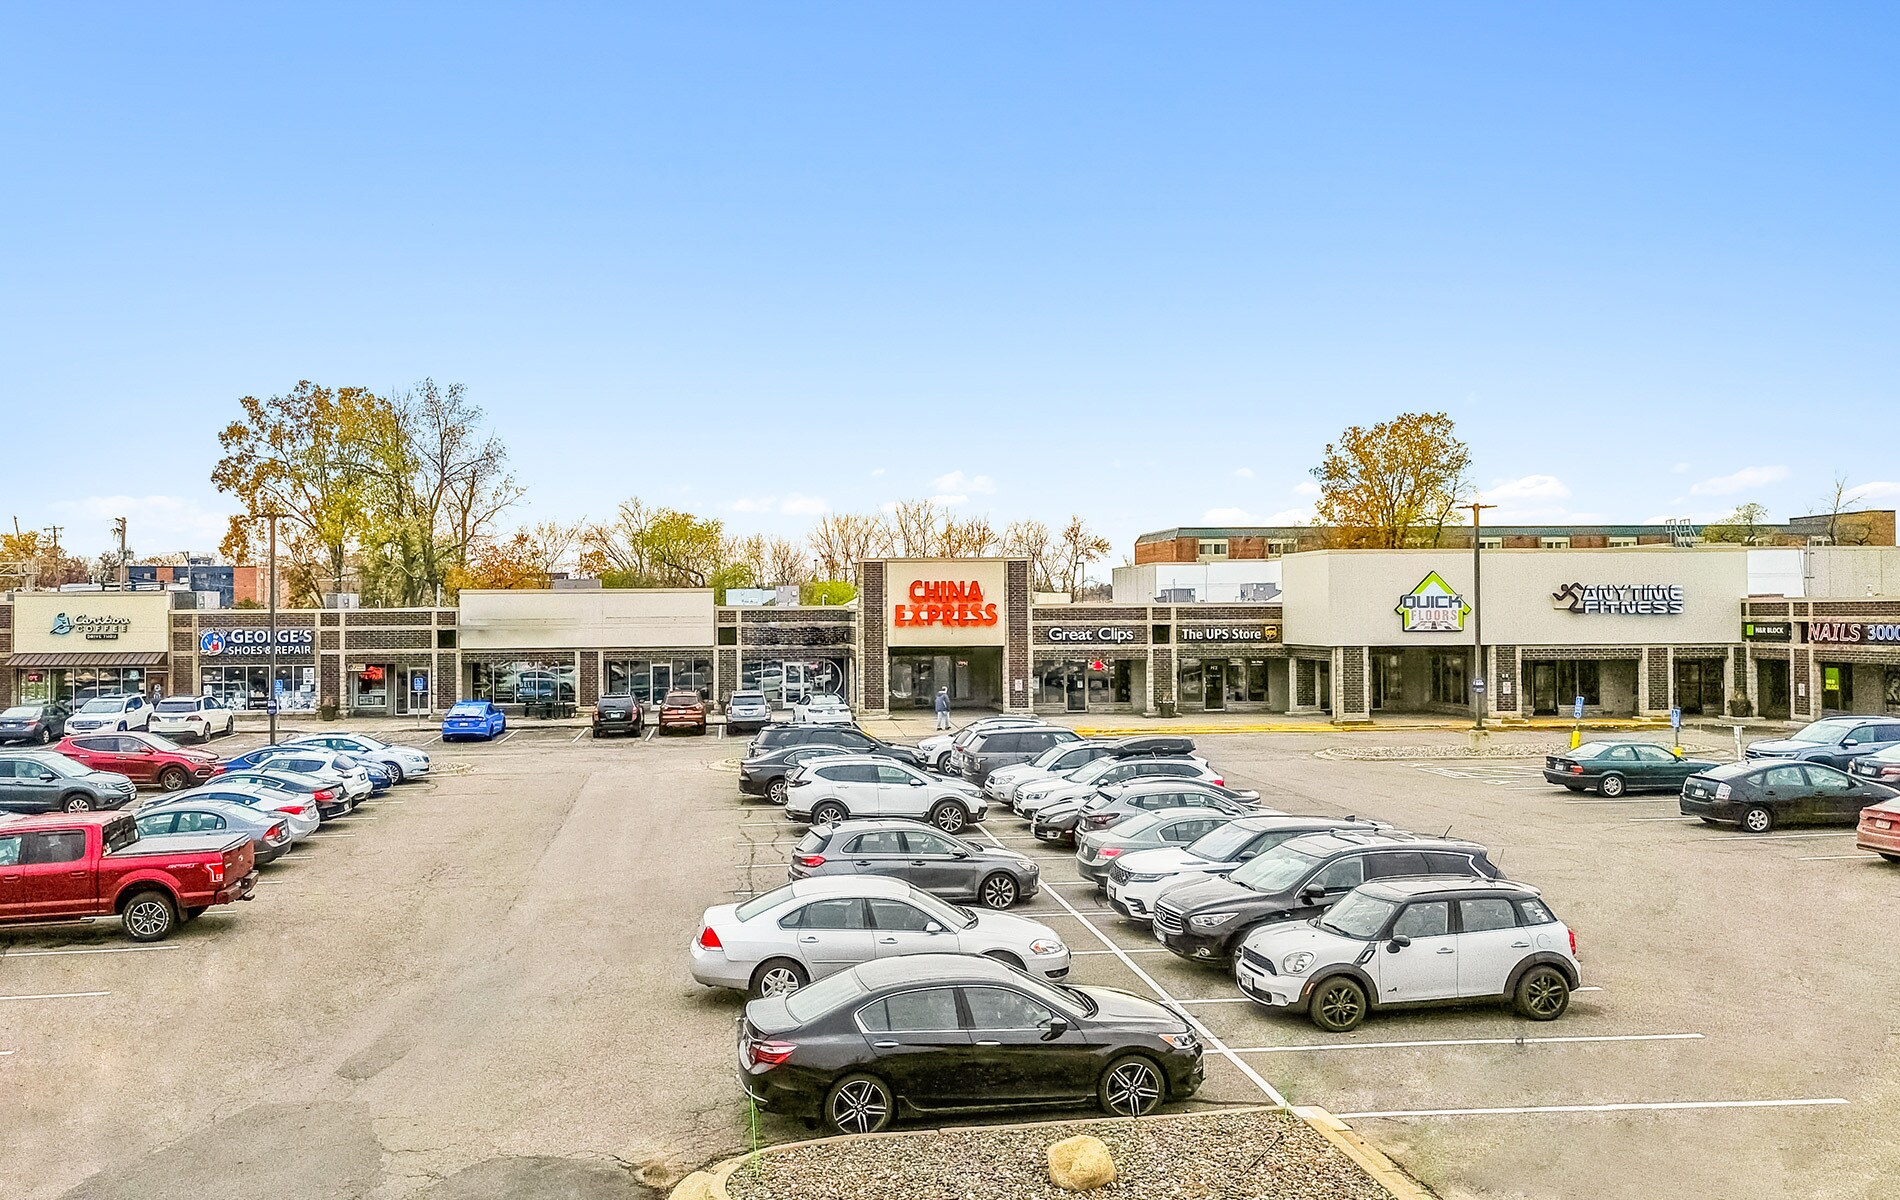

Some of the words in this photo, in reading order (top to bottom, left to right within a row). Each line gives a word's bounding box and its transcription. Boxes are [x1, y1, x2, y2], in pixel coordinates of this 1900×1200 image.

[909, 580, 983, 603] CHINA
[1581, 584, 1684, 600] ANYTIME
[1402, 594, 1463, 609] QUICK
[1583, 601, 1684, 614] FITNESS
[895, 603, 998, 627] EXPRESS
[1411, 609, 1457, 621] FLOORS
[76, 625, 128, 633] COFFEE
[1048, 627, 1093, 641] Great
[1098, 627, 1134, 644] Clips
[1182, 628, 1203, 640] The
[1206, 628, 1229, 640] UPS
[1231, 628, 1262, 640] Store
[1807, 623, 1861, 642] NAILS
[228, 645, 263, 655] SHOES
[264, 645, 271, 655] &
[274, 645, 312, 655] REPAIR
